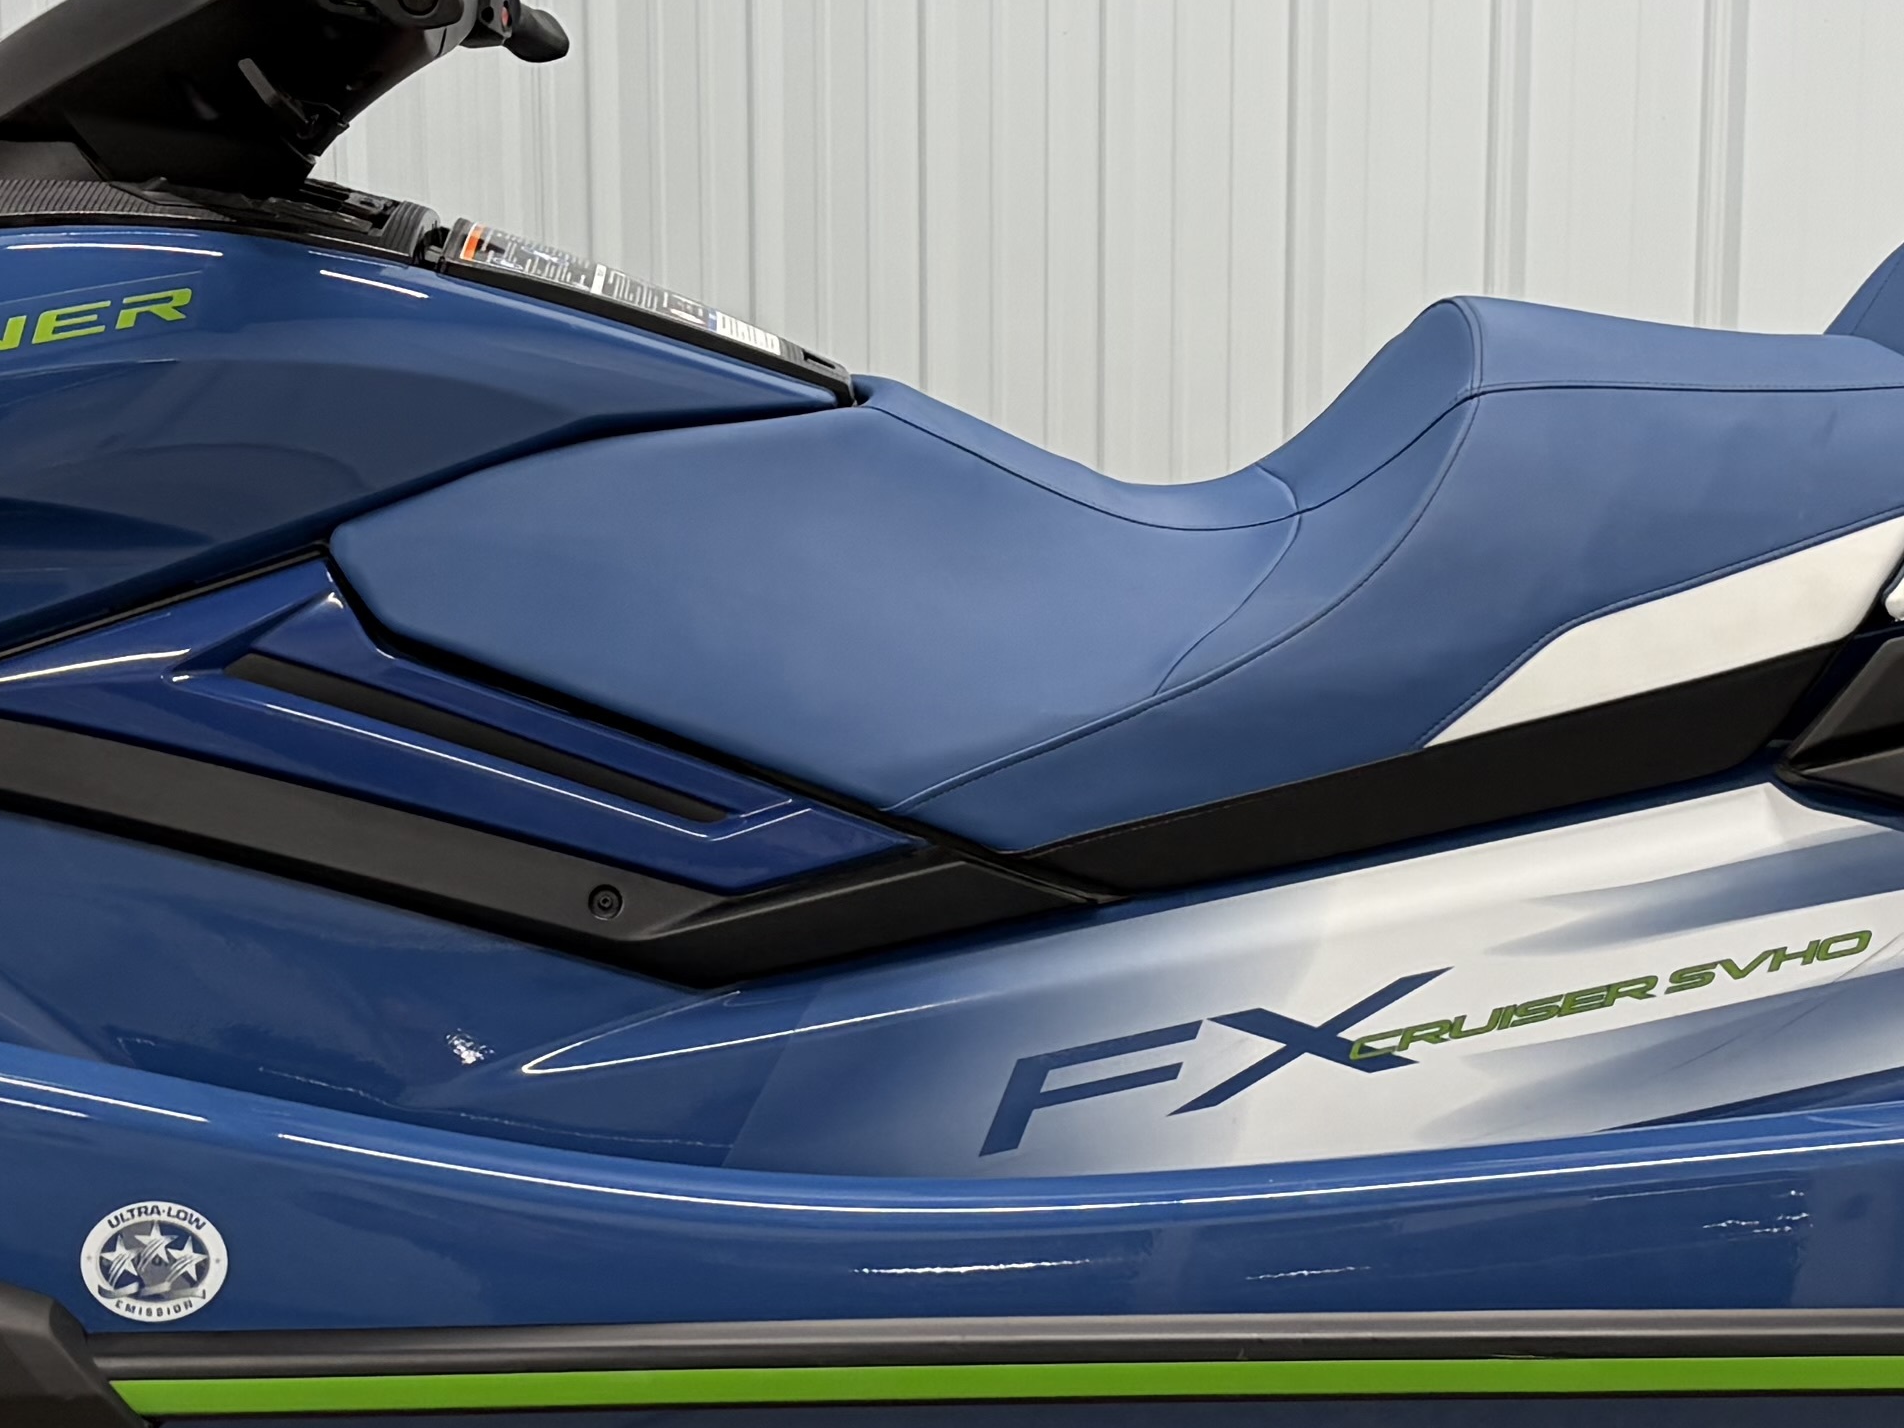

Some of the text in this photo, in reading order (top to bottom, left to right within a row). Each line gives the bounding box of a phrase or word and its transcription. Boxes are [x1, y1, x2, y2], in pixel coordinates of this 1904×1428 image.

[977, 929, 1873, 1157] FX CRUISER SVHO
[114, 1299, 194, 1317] EMISSION
